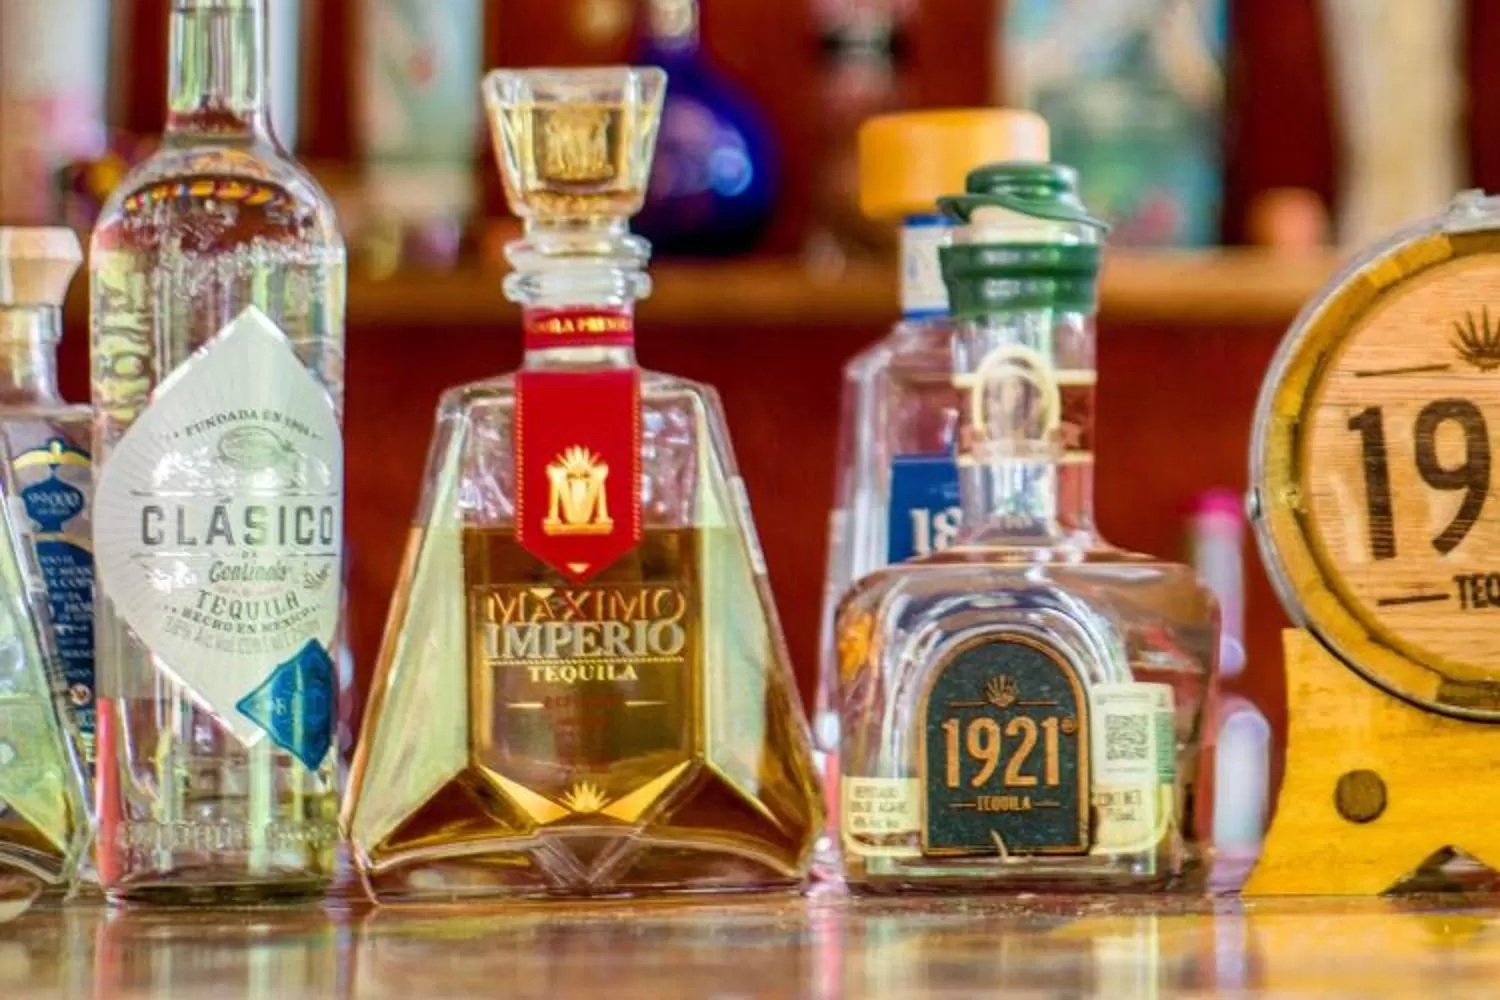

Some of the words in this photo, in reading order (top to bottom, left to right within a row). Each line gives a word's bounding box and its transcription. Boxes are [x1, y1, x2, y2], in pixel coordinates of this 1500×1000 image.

[184, 408, 259, 437] FUNDADA
[262, 408, 282, 423] EN
[141, 496, 334, 546] CLÁSICO
[197, 589, 301, 621] TEQUILA
[485, 618, 686, 660] IMPERIO
[527, 663, 639, 684] TEQUILA
[941, 716, 1060, 789] 1921
